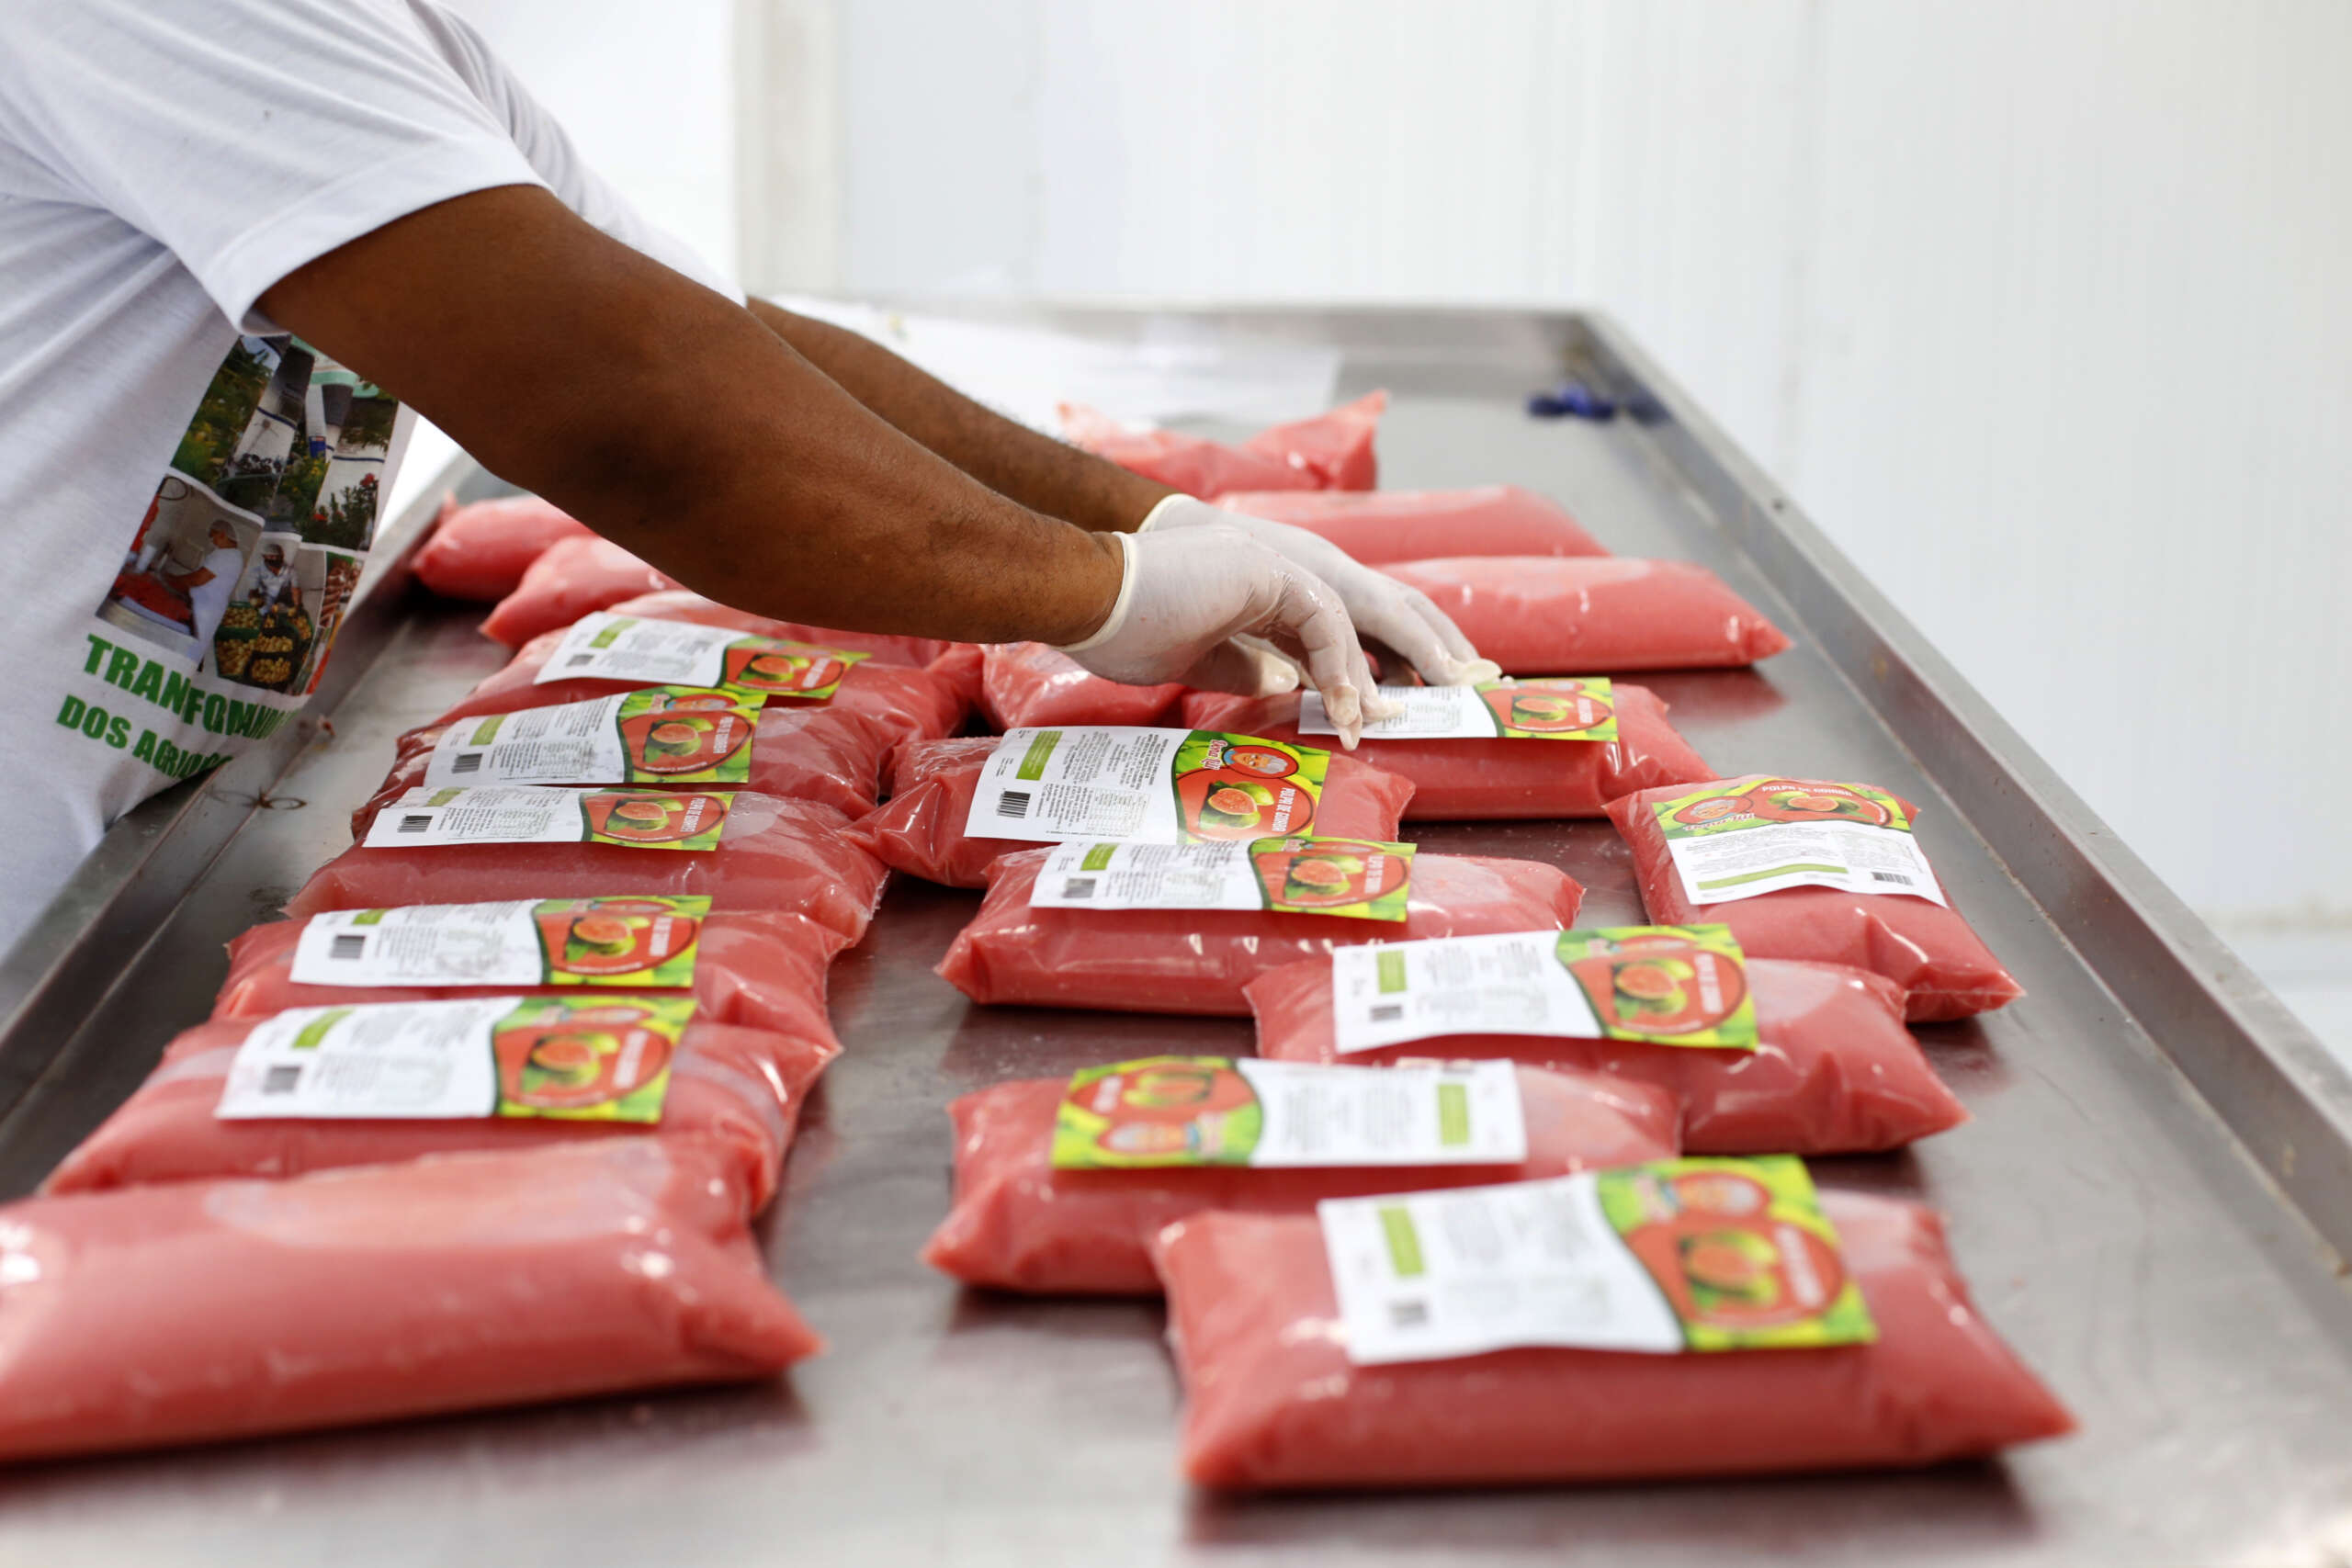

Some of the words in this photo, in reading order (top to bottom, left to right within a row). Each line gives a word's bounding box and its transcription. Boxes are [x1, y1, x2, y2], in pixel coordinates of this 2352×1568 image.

[56, 694, 131, 749] DOS
[1278, 787, 1295, 806] POLPA
[1276, 805, 1292, 813] DE
